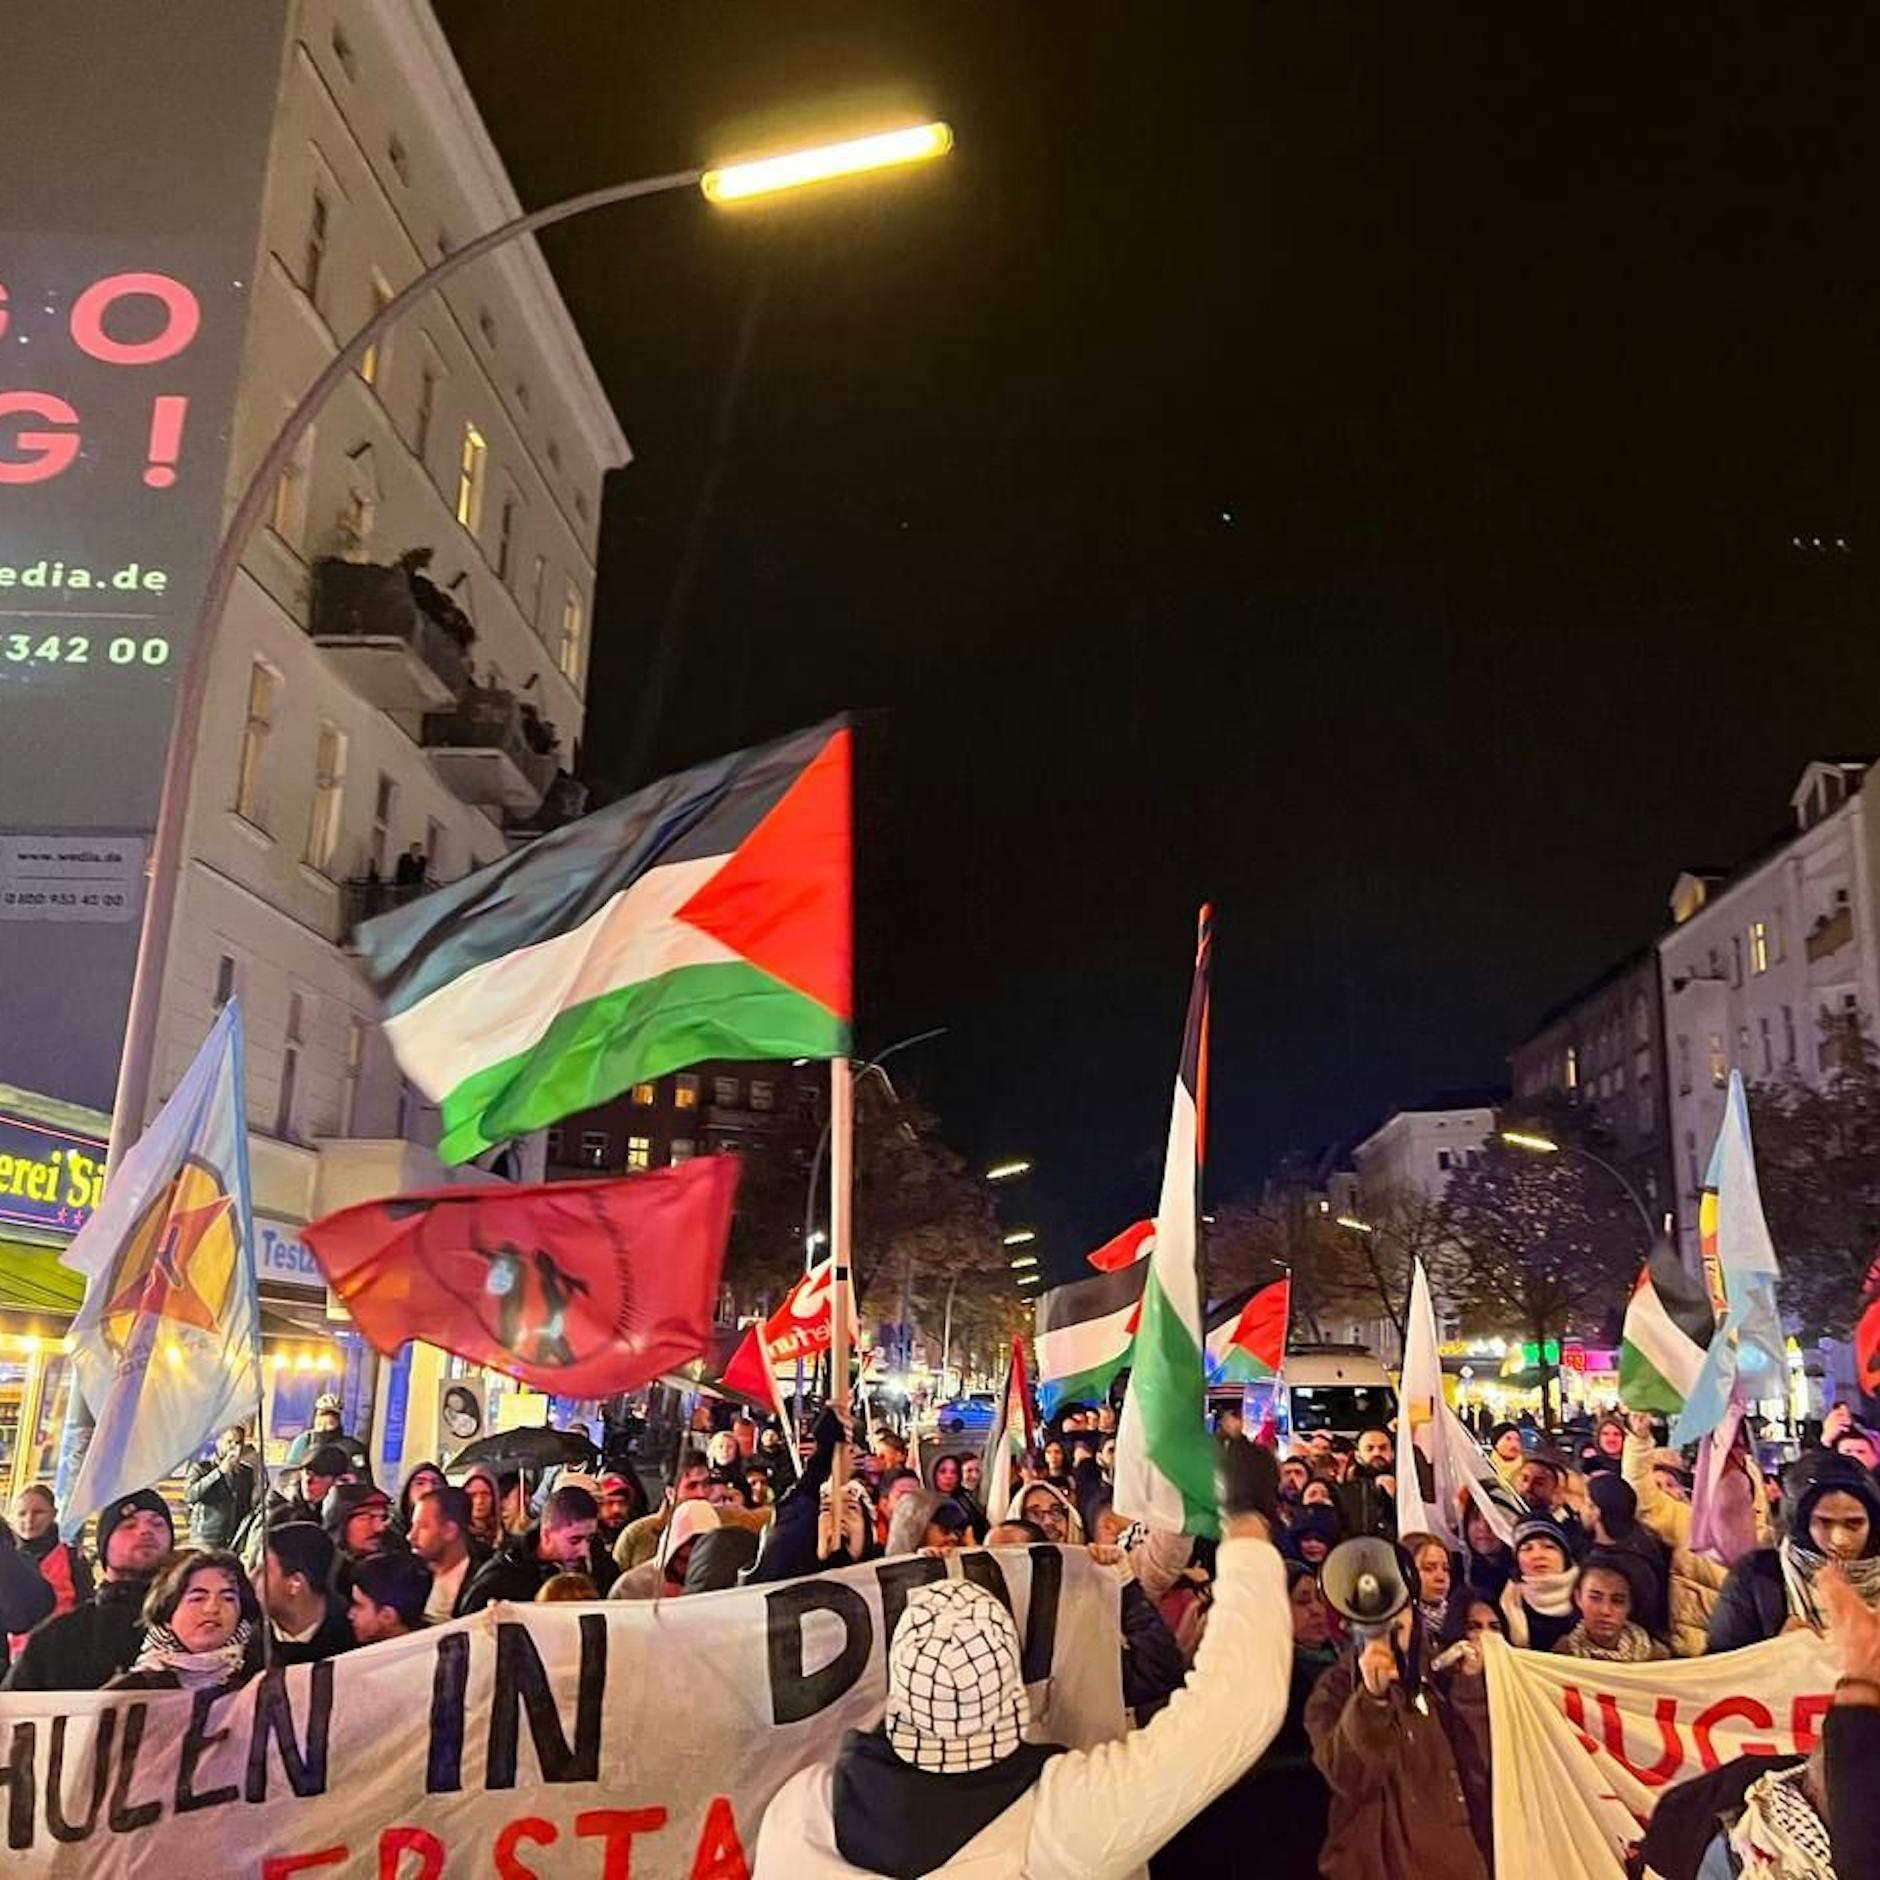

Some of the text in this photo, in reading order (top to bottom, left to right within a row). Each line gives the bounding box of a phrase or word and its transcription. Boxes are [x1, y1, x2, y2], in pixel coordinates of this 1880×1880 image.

[0, 272, 201, 365] O
[0, 560, 168, 591] edia.de
[0, 634, 170, 666] 342 00
[0, 1150, 61, 1203] erei
[426, 1613, 608, 1795] IN
[263, 1797, 752, 1880] STA
